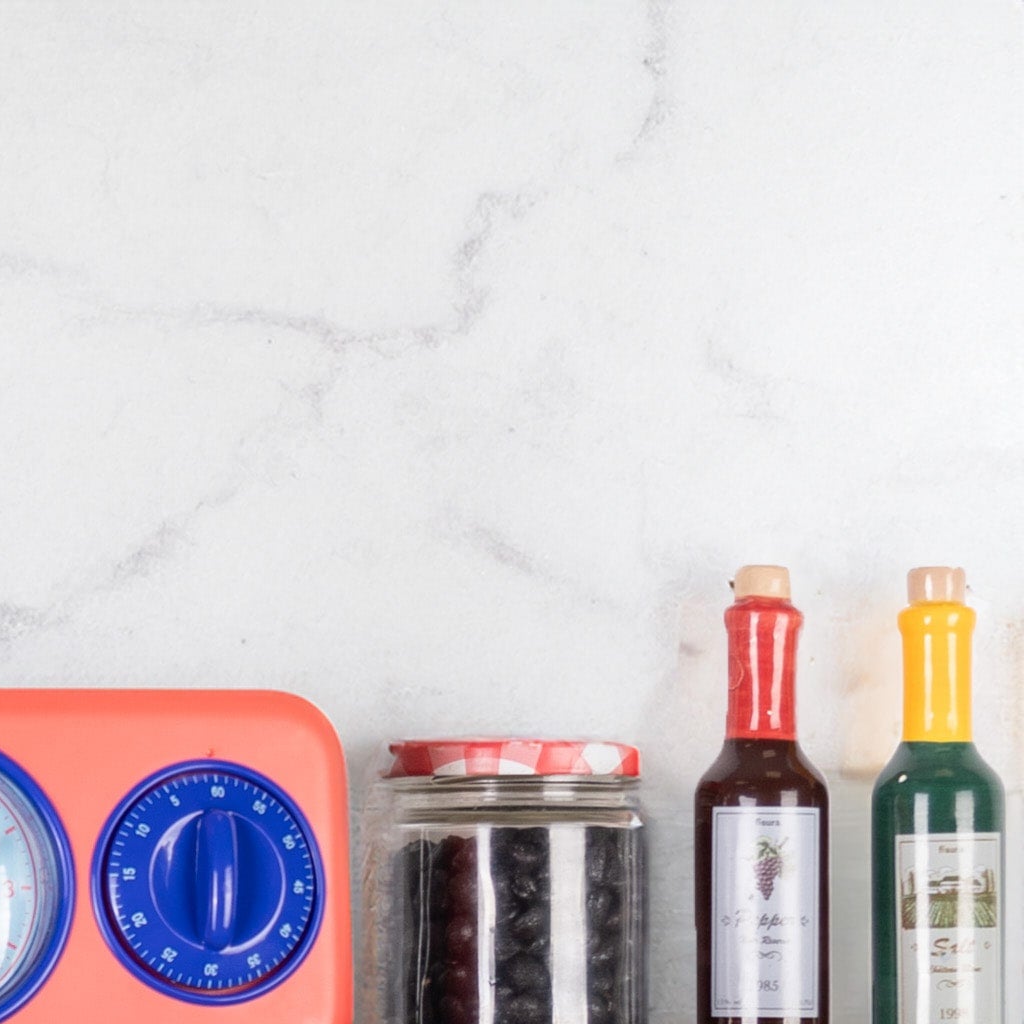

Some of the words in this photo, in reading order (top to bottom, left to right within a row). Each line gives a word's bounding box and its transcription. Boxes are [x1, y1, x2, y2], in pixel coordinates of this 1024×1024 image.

[169, 795, 181, 807] 5
[252, 801, 268, 815] 55
[134, 823, 151, 838] 10
[122, 867, 136, 881] 15
[2, 880, 14, 898] 3
[293, 880, 304, 894] 45
[131, 912, 148, 928] 20
[279, 923, 292, 938] 40
[161, 947, 178, 963] 25
[247, 953, 262, 969] 35
[204, 964, 219, 976] 30
